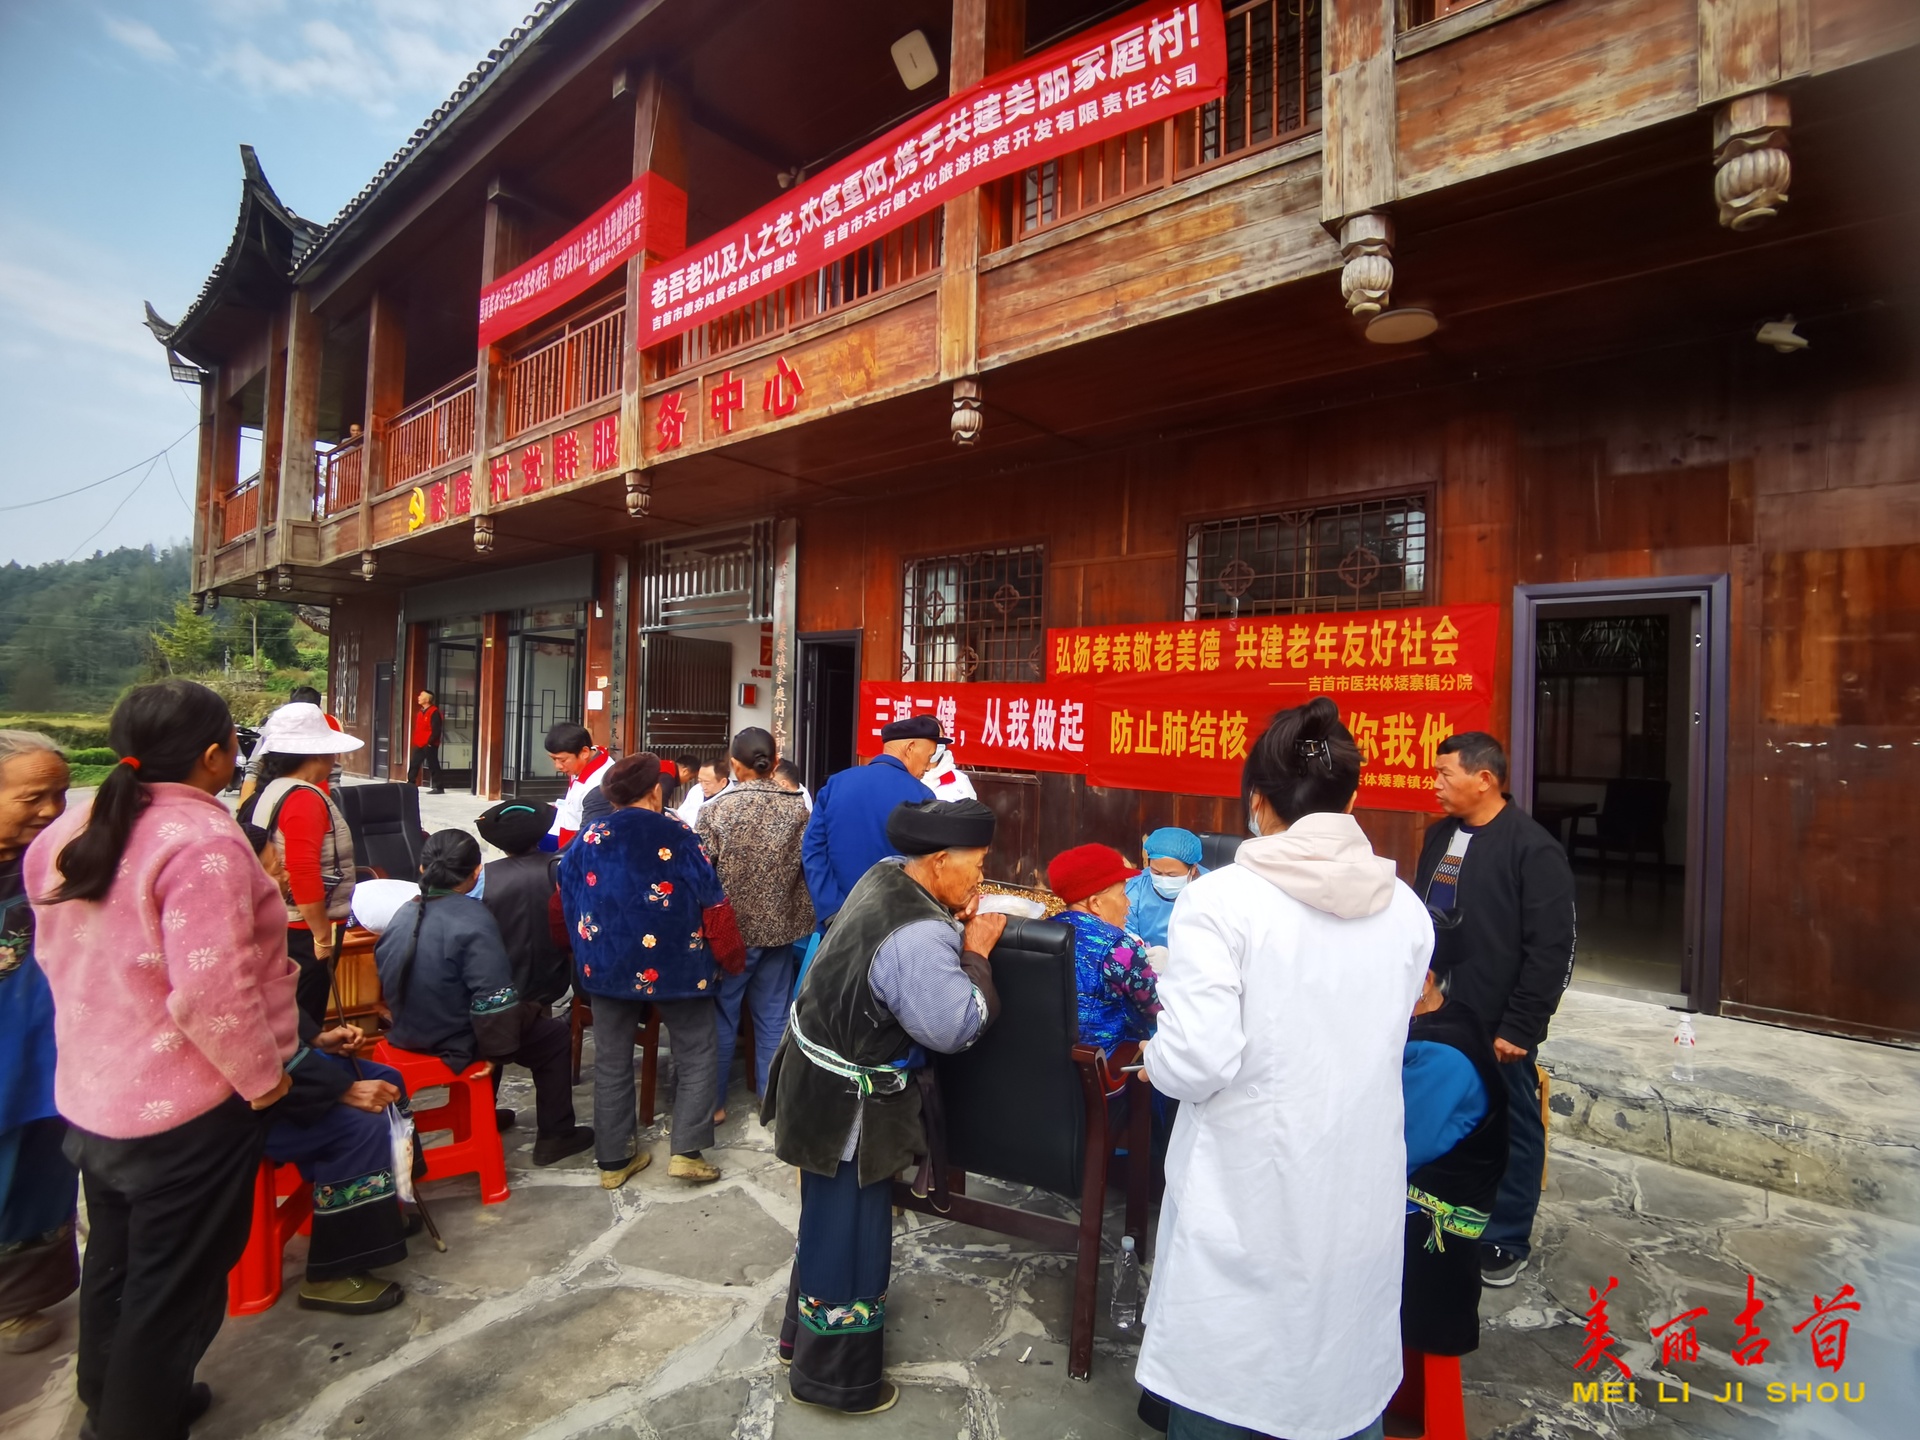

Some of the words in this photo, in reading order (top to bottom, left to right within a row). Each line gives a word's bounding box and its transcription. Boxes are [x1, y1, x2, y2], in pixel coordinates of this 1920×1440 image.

[652, 250, 798, 332] 吉首市德夯风景名胜区管理处
[823, 63, 1197, 249] 吉首市天行健文化旅游投资开发有限责任公司
[430, 355, 805, 522] 家庭村党群服务中心
[1055, 627, 1221, 675] 弘扬孝亲敬老美德
[1234, 614, 1460, 670] 共建老年友好社会
[1110, 709, 1249, 761] 防止肺结核
